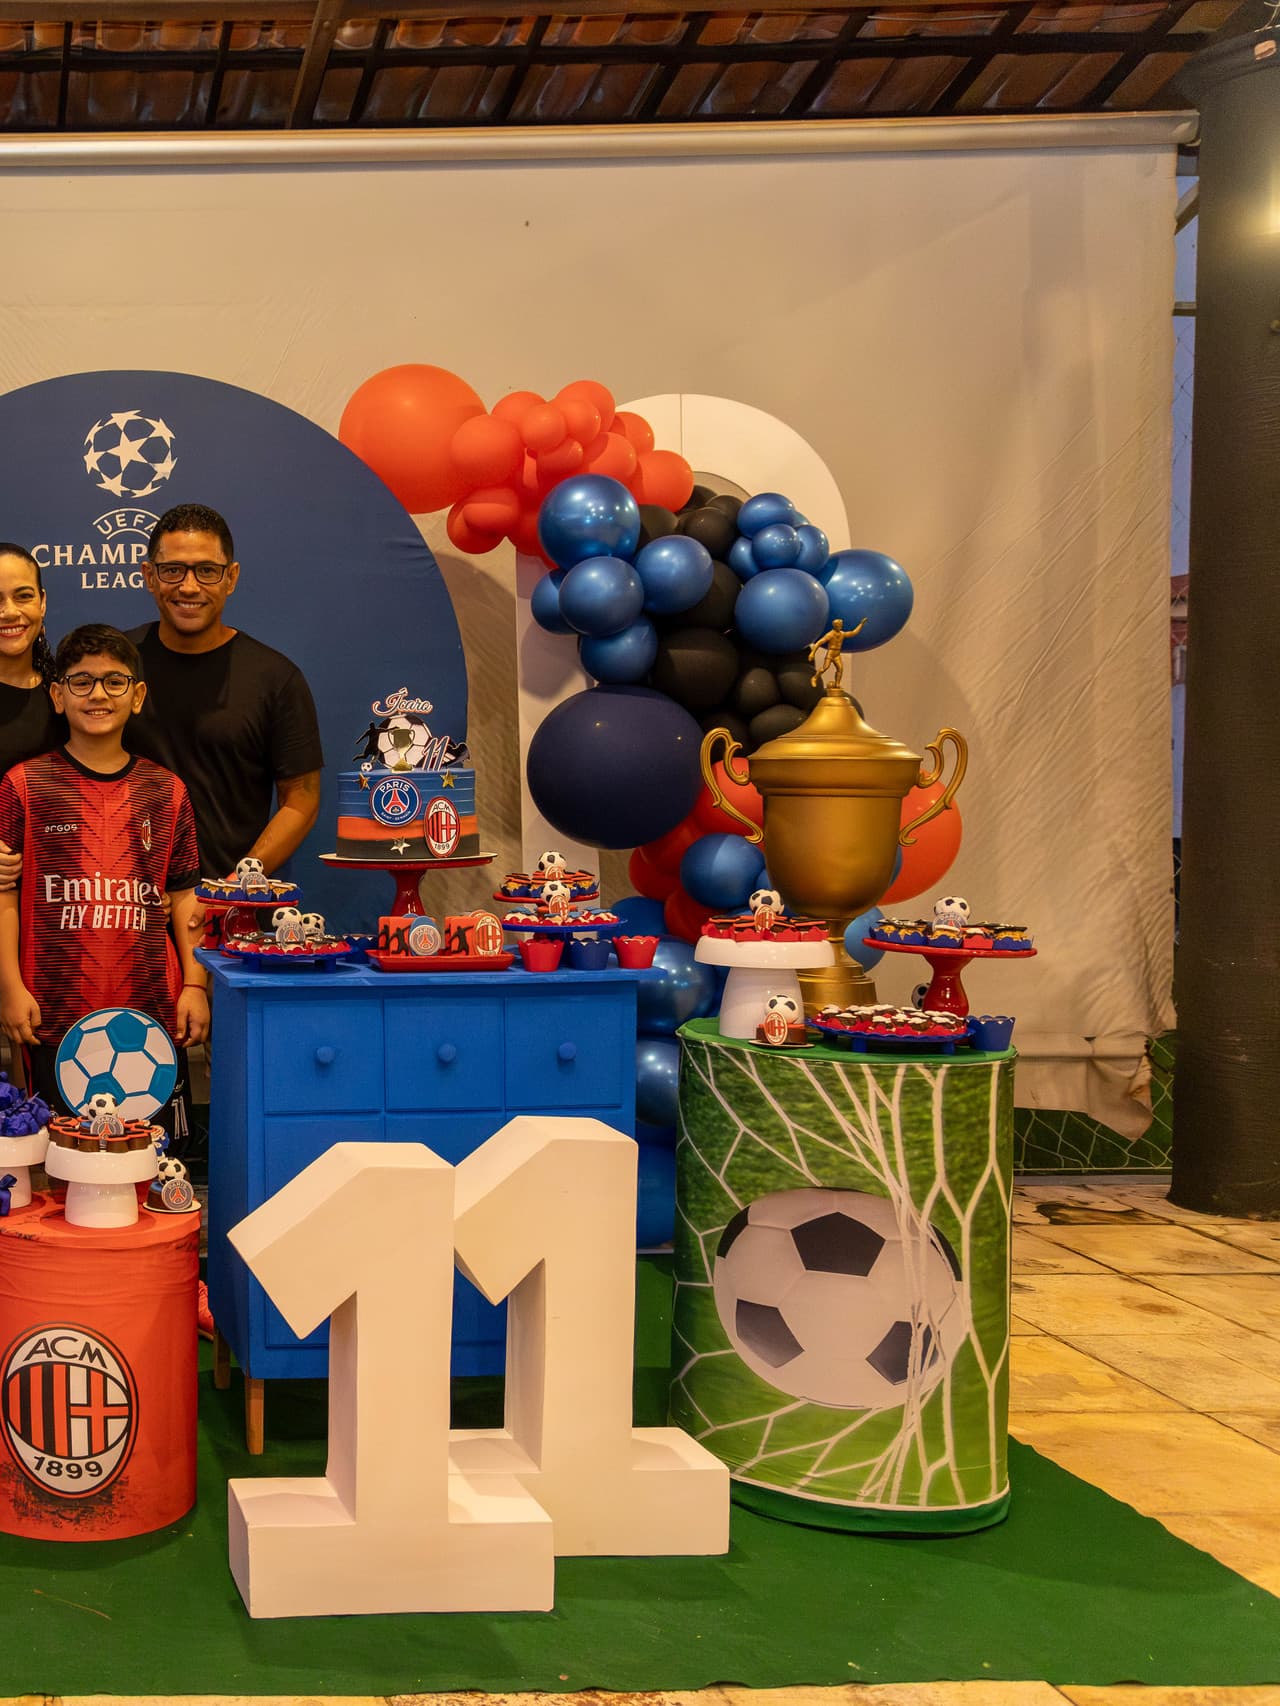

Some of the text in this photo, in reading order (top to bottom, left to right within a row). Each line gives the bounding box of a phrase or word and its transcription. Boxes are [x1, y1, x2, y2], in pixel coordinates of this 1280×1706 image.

[30, 543, 149, 568] CHAMP
[80, 571, 145, 589] LEAG
[422, 735, 451, 771] 11
[379, 781, 410, 793] PARIS
[431, 801, 452, 813] ACM
[43, 871, 163, 906] Emirates
[60, 904, 147, 931] FLY BETTER
[23, 1336, 109, 1369] ACM
[33, 1456, 103, 1479] 1899
